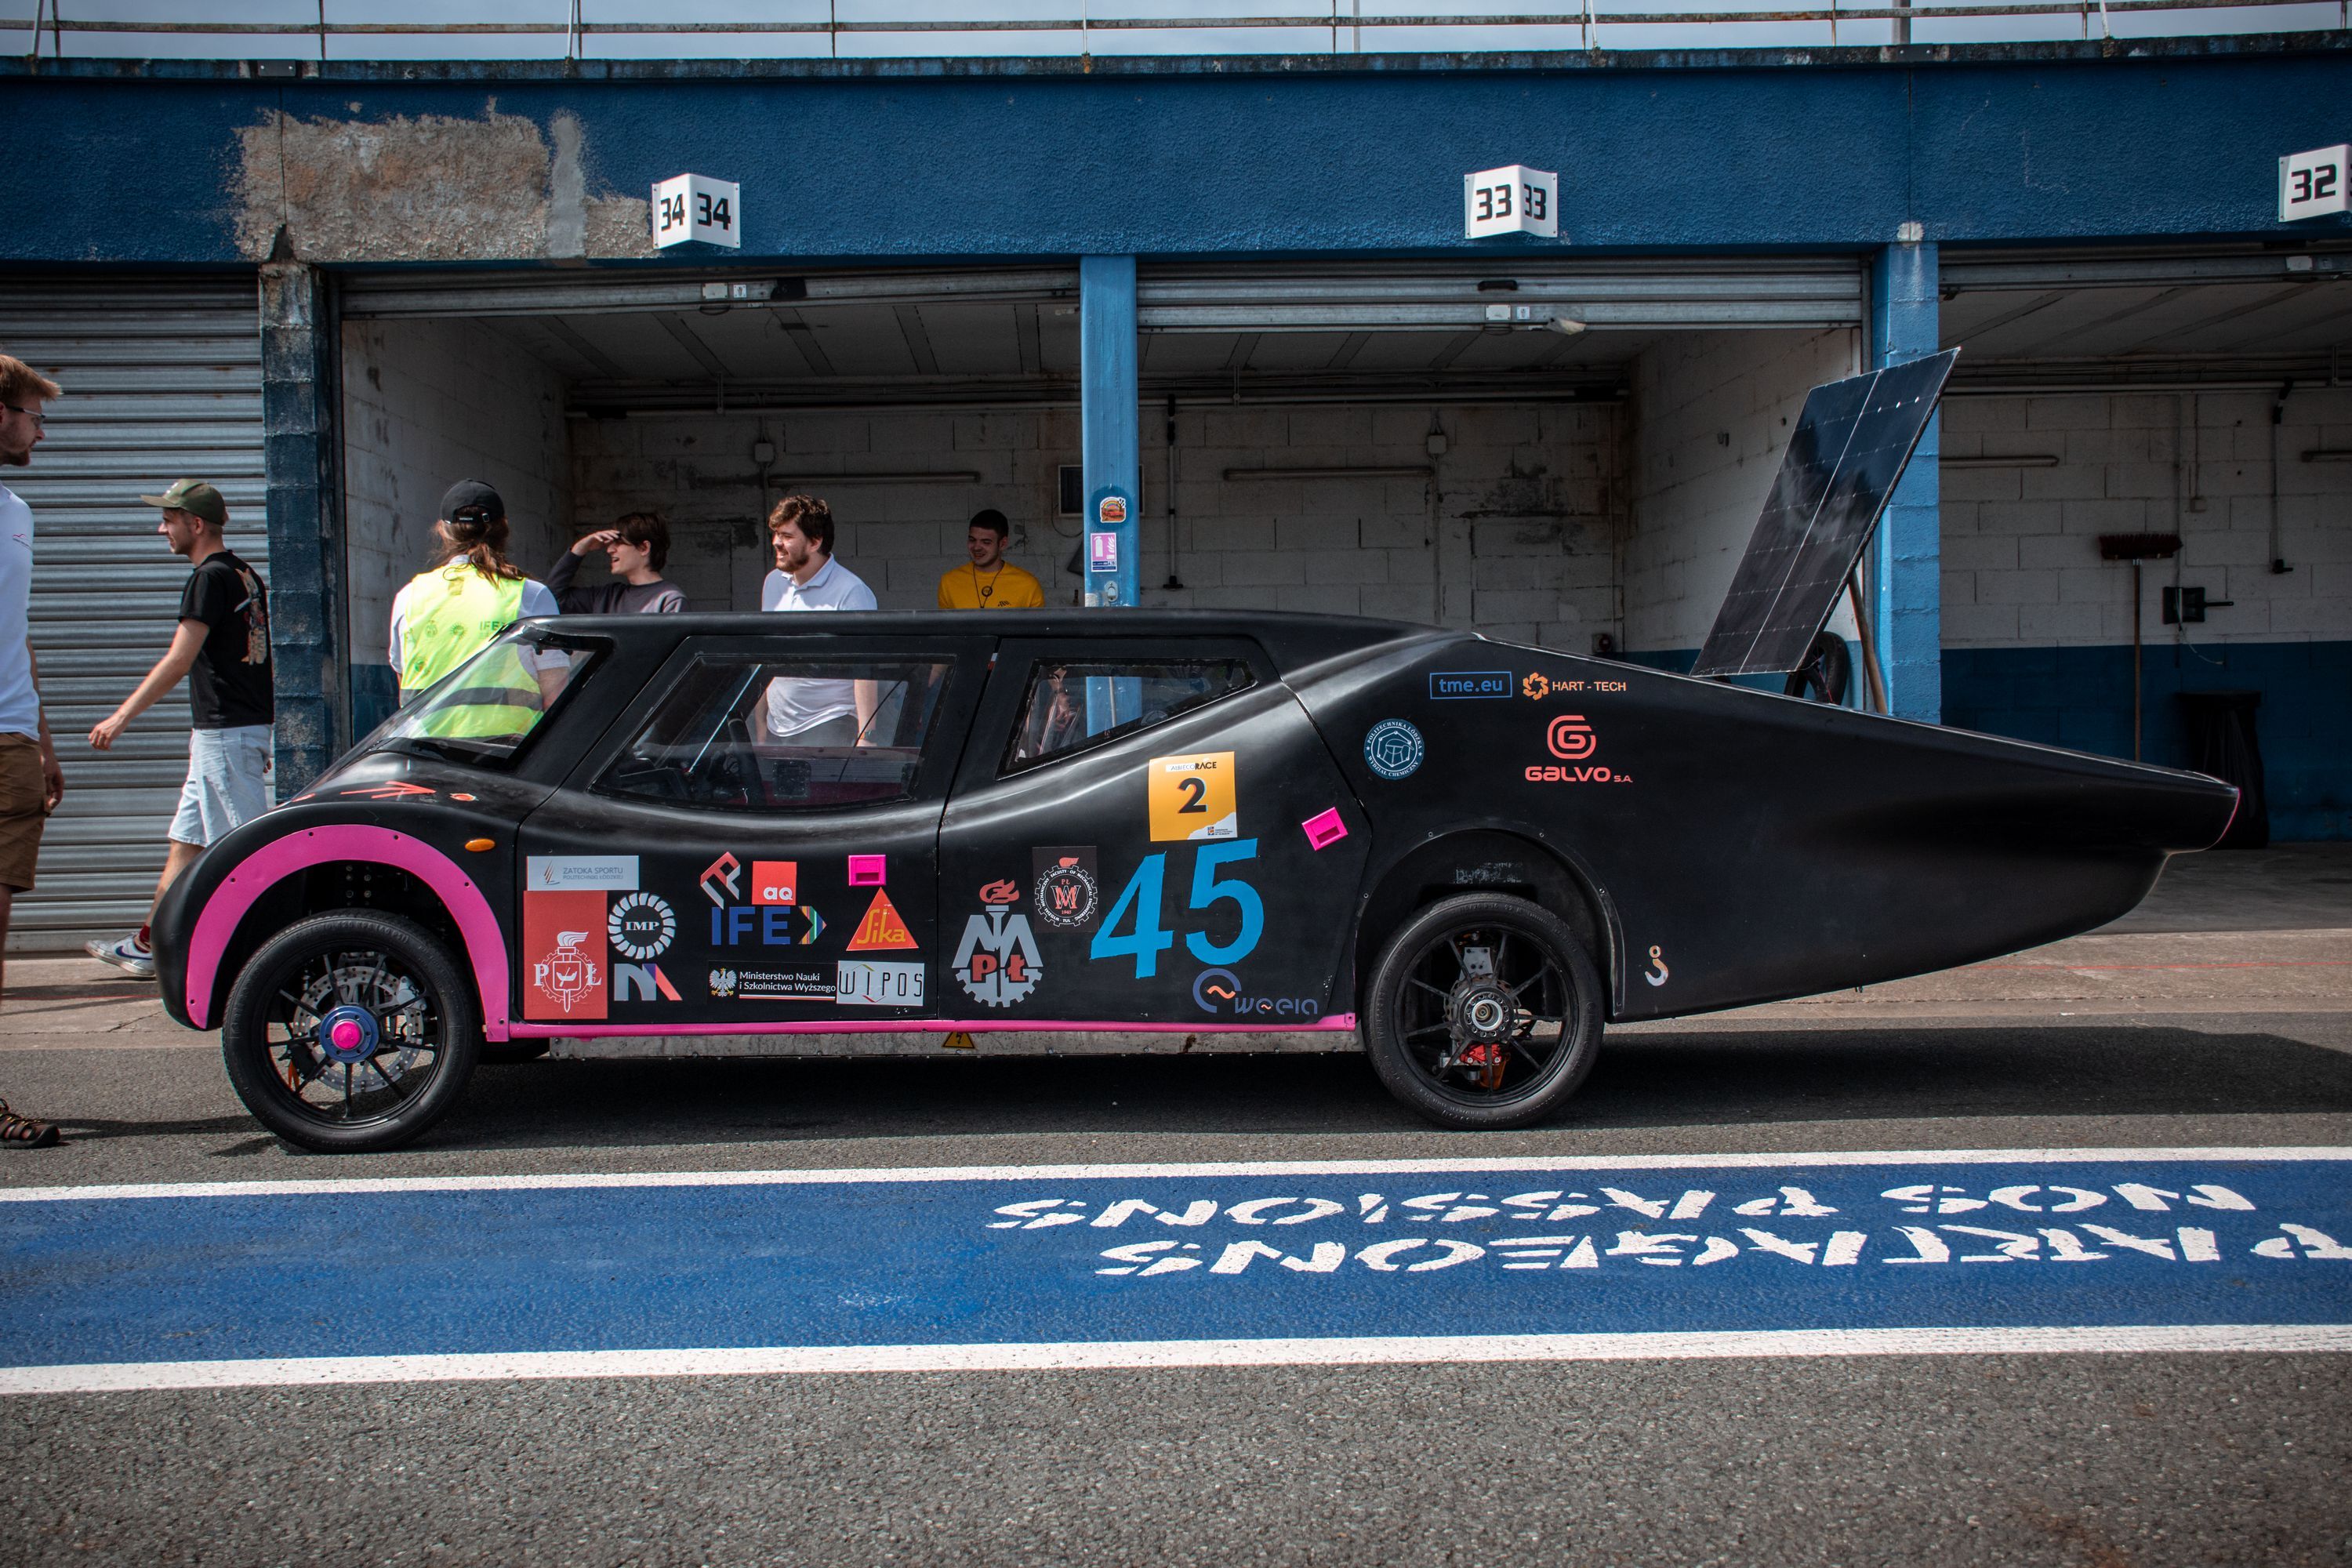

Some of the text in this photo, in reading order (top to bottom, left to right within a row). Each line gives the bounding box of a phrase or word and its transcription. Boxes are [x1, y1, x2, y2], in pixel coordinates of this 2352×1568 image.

[1523, 183, 1547, 221] 33
[2291, 163, 2337, 205] 32
[660, 193, 685, 232] 34
[697, 191, 731, 231] 34
[1475, 183, 1512, 222] 33
[1439, 678, 1503, 693] tme.eu
[1552, 681, 1584, 691] HART
[1593, 681, 1627, 691] TECH
[1367, 721, 1406, 743] POLITECHNIKA
[1388, 760, 1419, 777] CHEMICZNY
[1525, 766, 1611, 782] GALVO
[1177, 777, 1208, 814] 2
[625, 920, 660, 931] IMP
[711, 906, 791, 946] IFE
[856, 908, 906, 944] Sika
[1089, 837, 1265, 979] 45
[739, 971, 820, 982] Ministerstwo Nauki
[743, 982, 793, 991] Szkolnictwa
[794, 982, 837, 993] Wyższego
[839, 971, 923, 997] WIPOS
[985, 1181, 2262, 1232] NOS PASSIONS
[1095, 1221, 2352, 1277] PARTAGEONS
